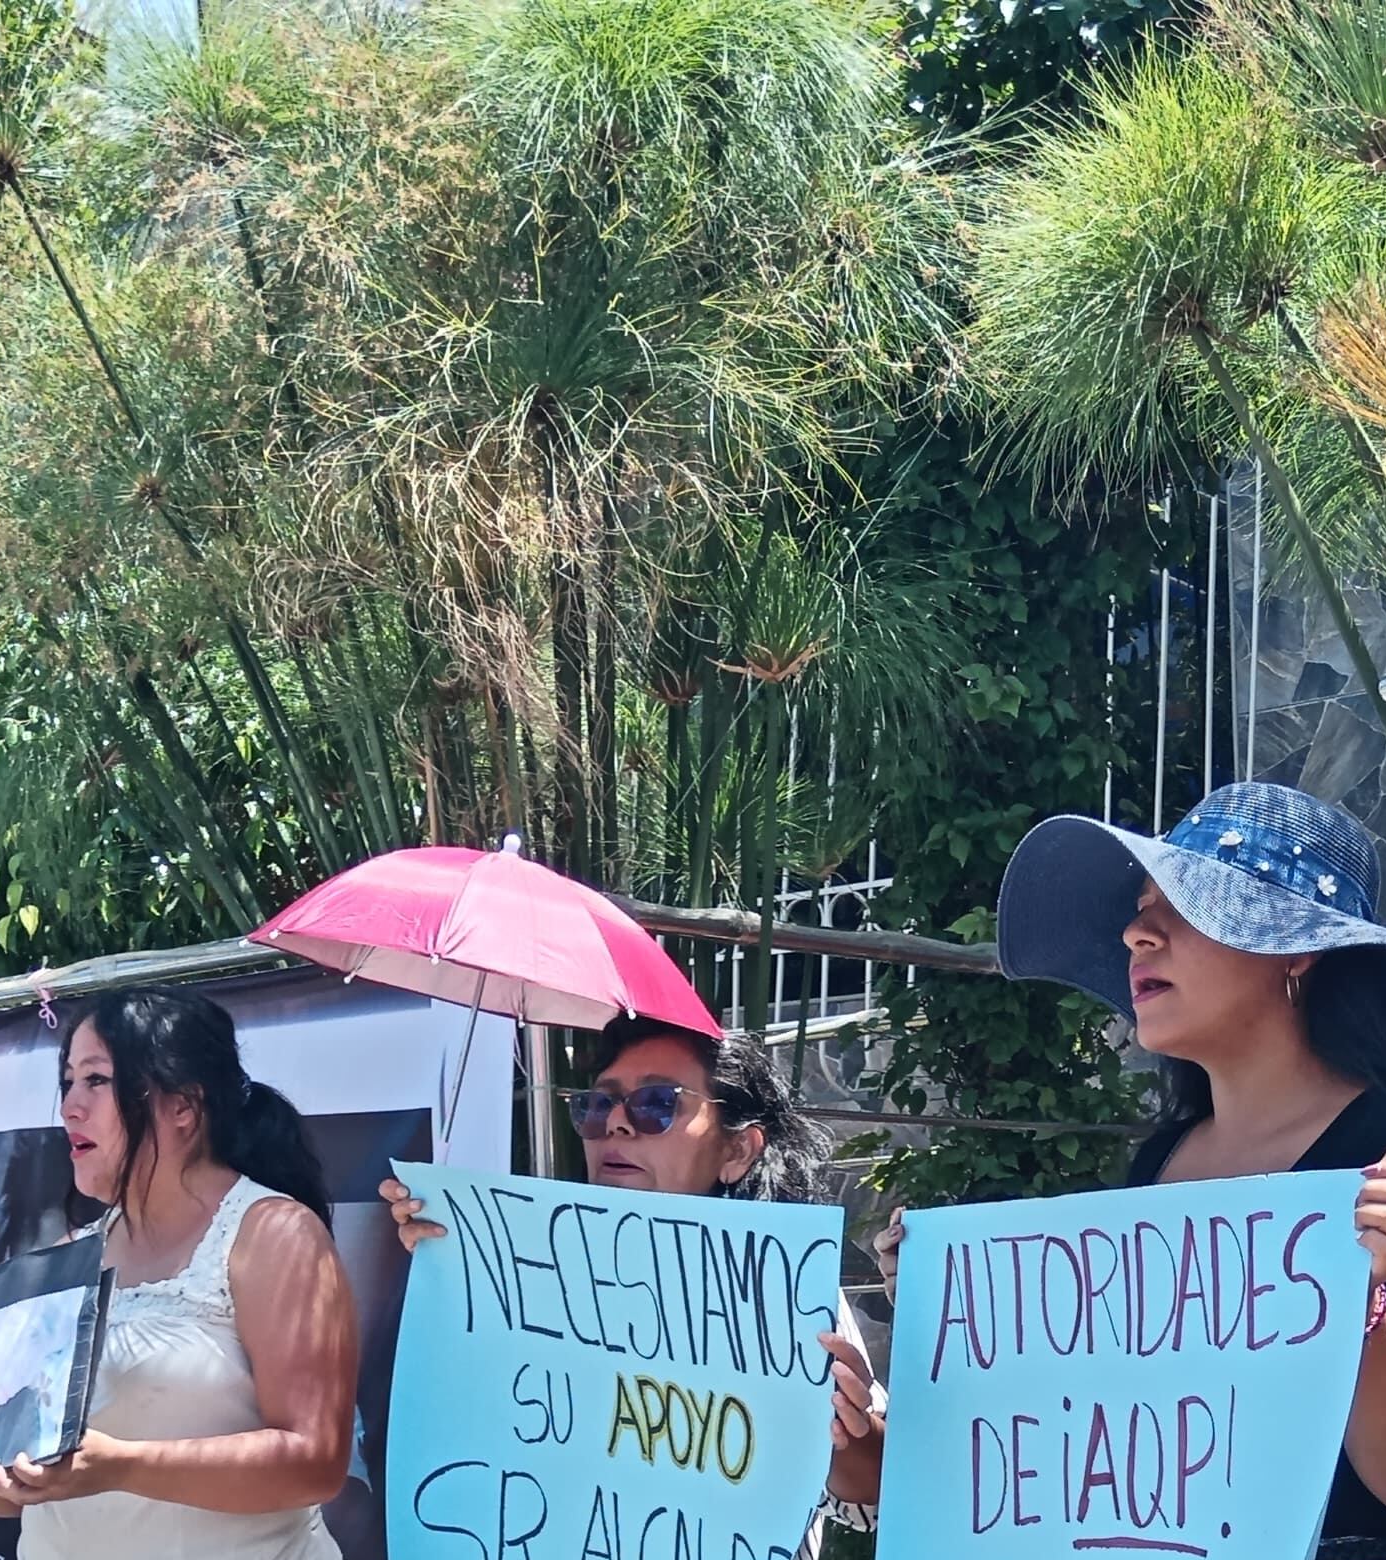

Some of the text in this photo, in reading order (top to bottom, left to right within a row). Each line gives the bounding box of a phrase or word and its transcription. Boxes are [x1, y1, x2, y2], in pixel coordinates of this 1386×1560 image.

[443, 1184, 837, 1386] NECESITAMOS
[930, 1211, 1327, 1384] AUTORIDADES
[513, 1363, 754, 1484] SU APOYO
[972, 1414, 1042, 1535] DE
